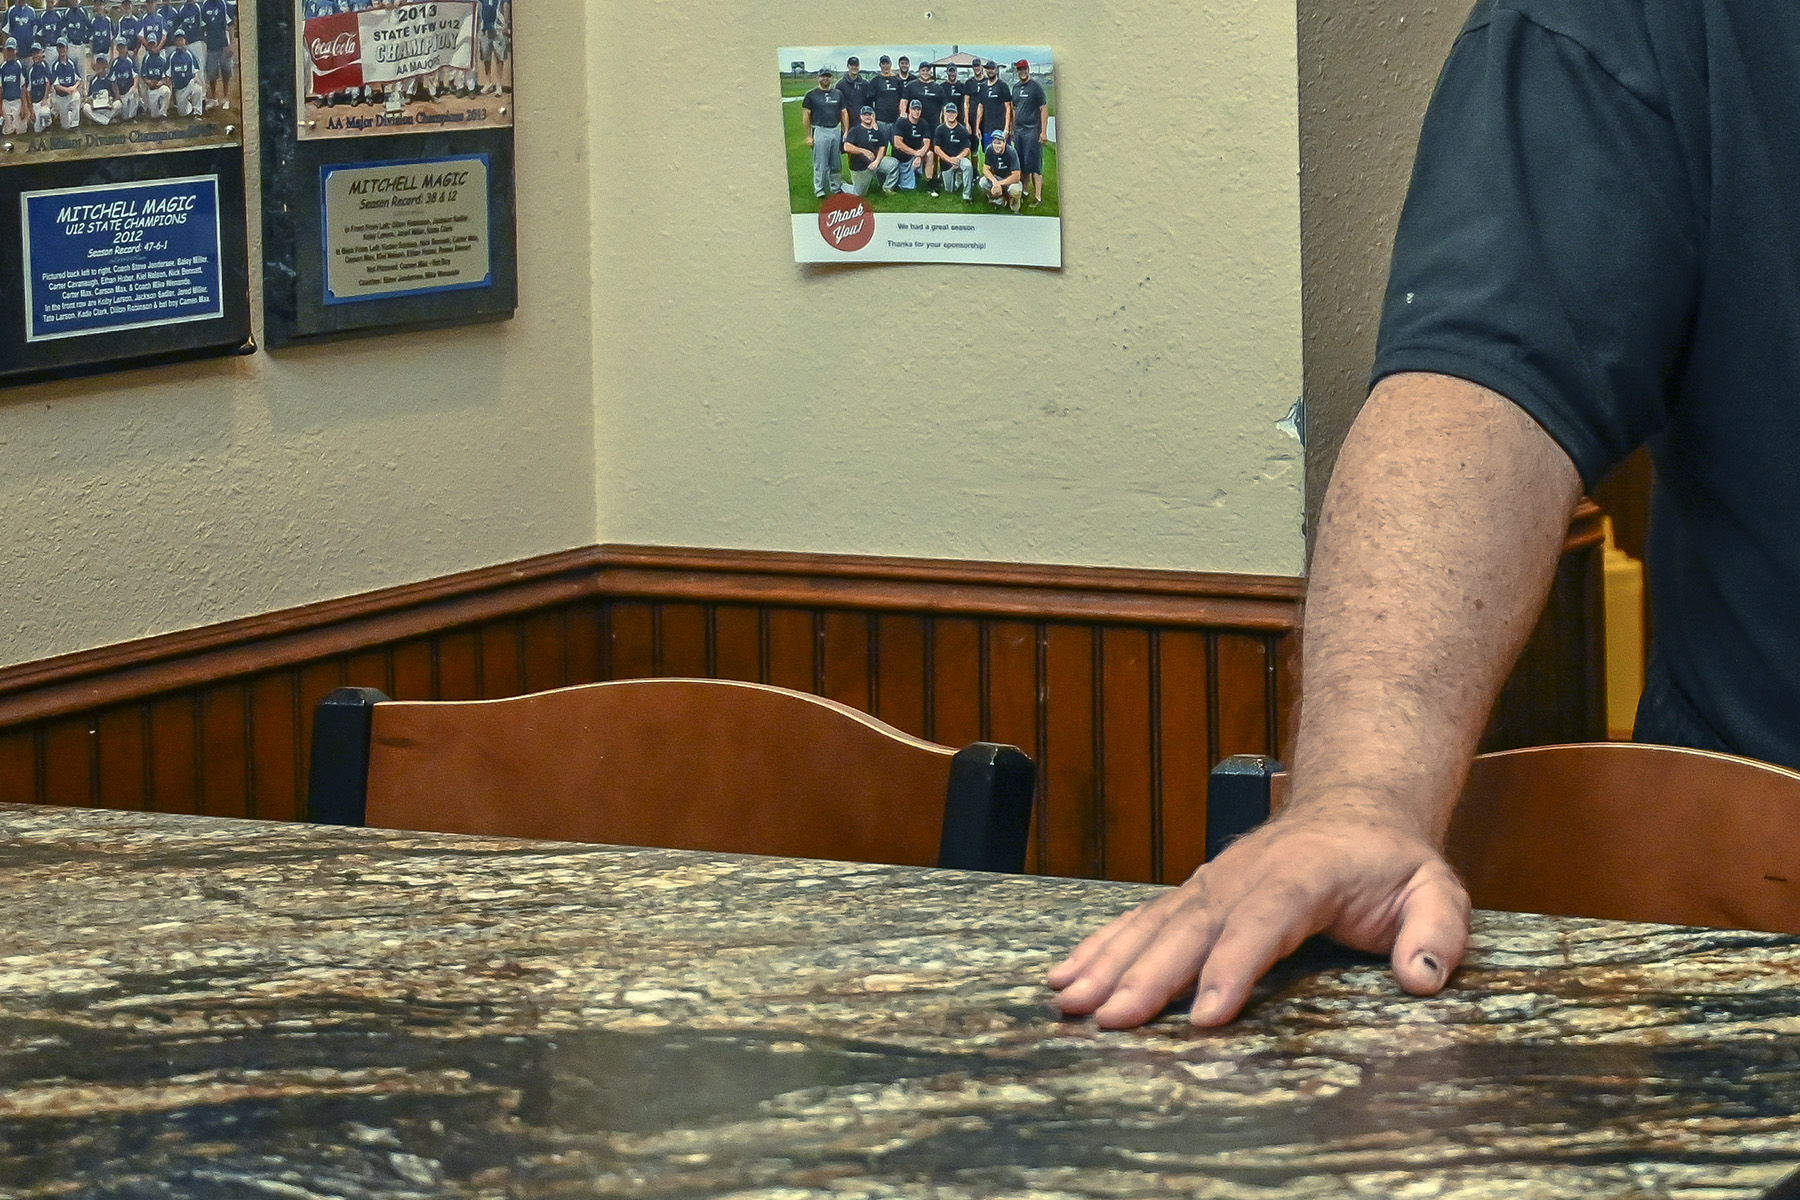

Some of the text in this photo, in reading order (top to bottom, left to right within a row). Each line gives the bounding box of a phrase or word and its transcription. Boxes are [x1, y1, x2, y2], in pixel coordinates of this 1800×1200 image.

[398, 5, 438, 23] 2013
[373, 28, 410, 42] STATE
[346, 115, 374, 131] Major
[349, 171, 469, 195] MITCHELL MAGIC
[56, 195, 197, 223] MITCHELL MAGIC
[359, 199, 390, 210] Season
[827, 203, 864, 227] Thank
[65, 213, 188, 236] U12 STATE CHAMPIONS
[833, 219, 864, 245] You!
[897, 223, 910, 231] We
[911, 223, 924, 231] had
[931, 223, 949, 234] great
[113, 230, 144, 244] 2012
[888, 240, 913, 249] Thanks
[914, 240, 924, 249] for
[926, 242, 941, 250] your
[87, 247, 113, 258] Season
[144, 240, 168, 252] 47-6-1
